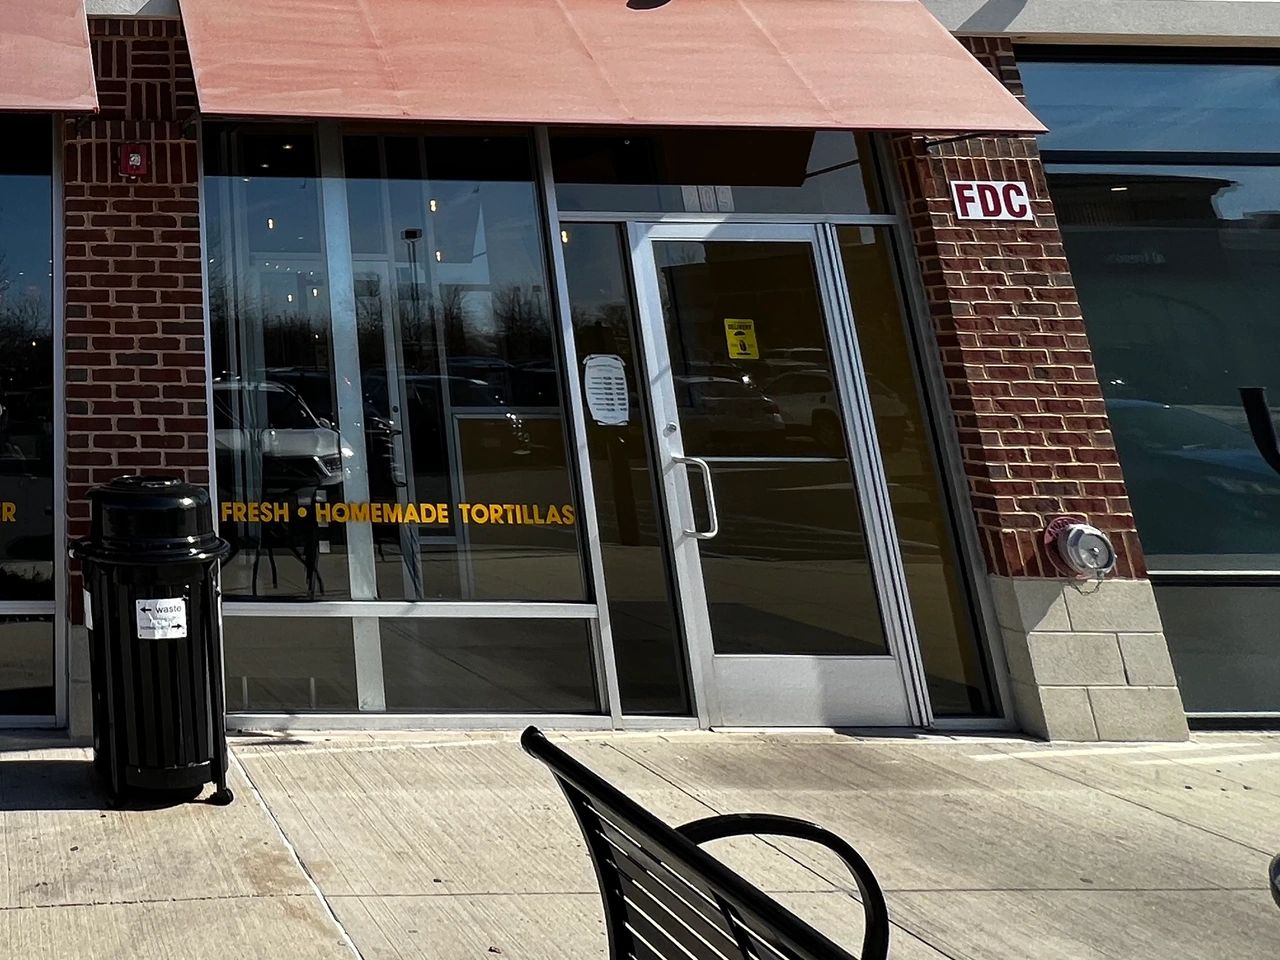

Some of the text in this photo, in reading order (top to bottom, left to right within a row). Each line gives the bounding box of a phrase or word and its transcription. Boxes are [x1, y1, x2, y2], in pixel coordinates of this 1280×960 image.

[954, 183, 1028, 218] FDC
[221, 501, 576, 525] FRESH HOMEMADE TORTILLAS
